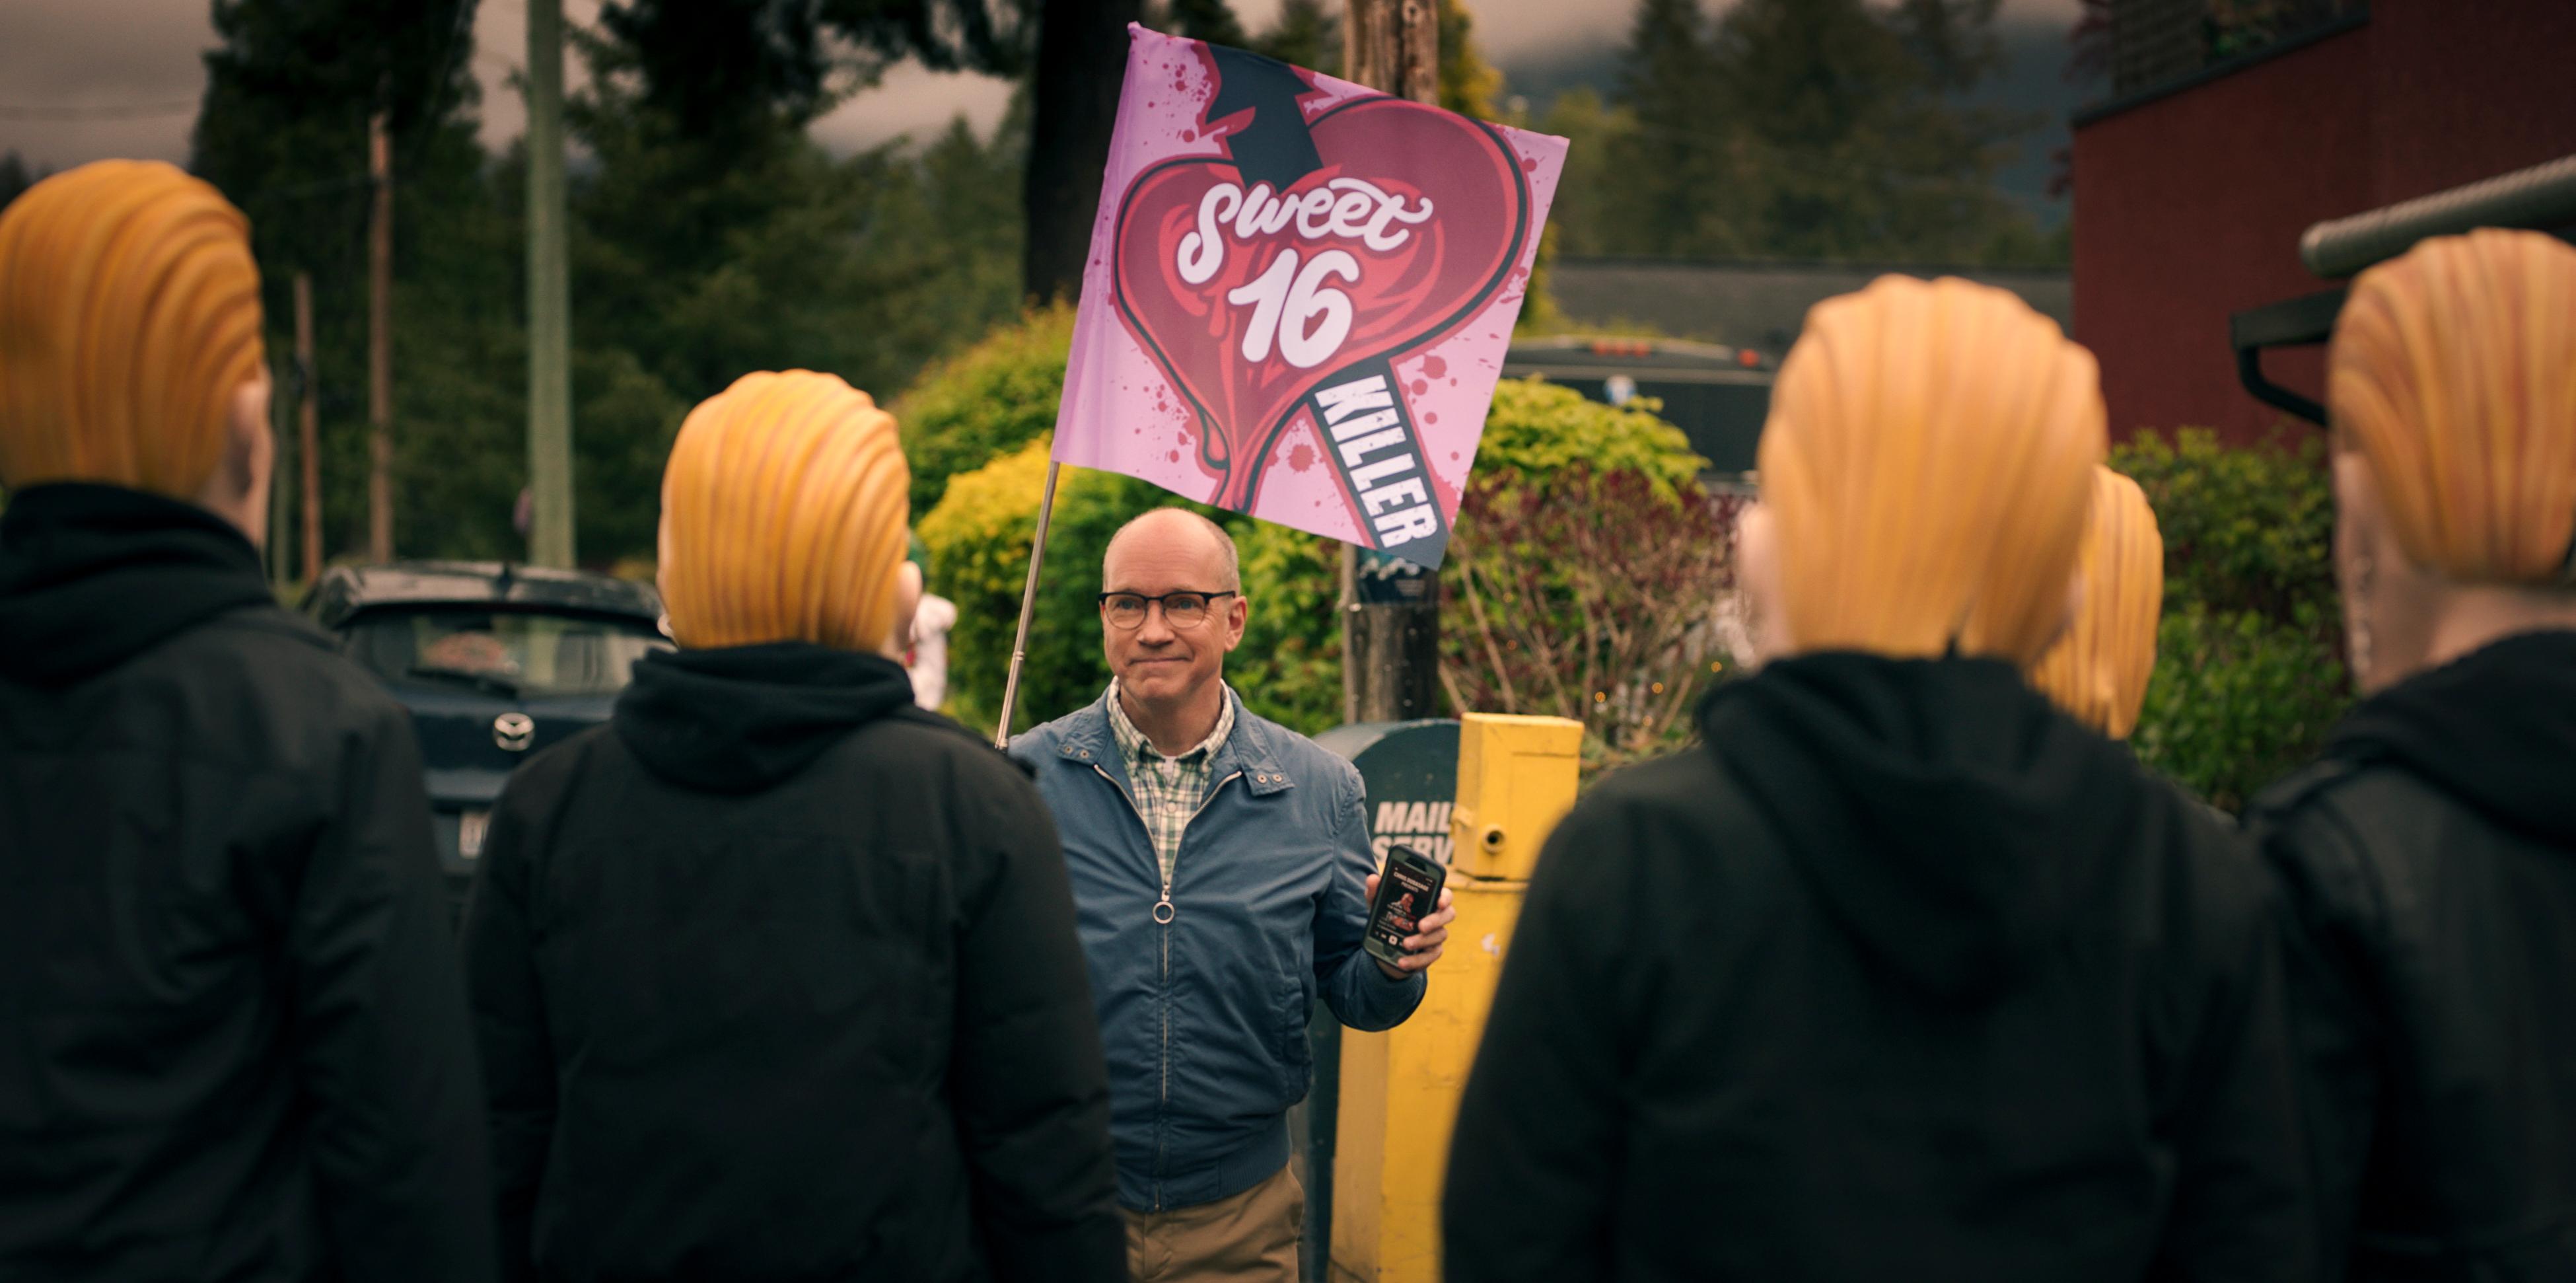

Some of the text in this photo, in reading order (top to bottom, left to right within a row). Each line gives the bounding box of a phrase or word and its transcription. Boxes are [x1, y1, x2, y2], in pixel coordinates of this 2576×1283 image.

[1229, 248, 1359, 368] 16
[1314, 375, 1438, 548] KILLER
[1374, 801, 1451, 833] MAIL
